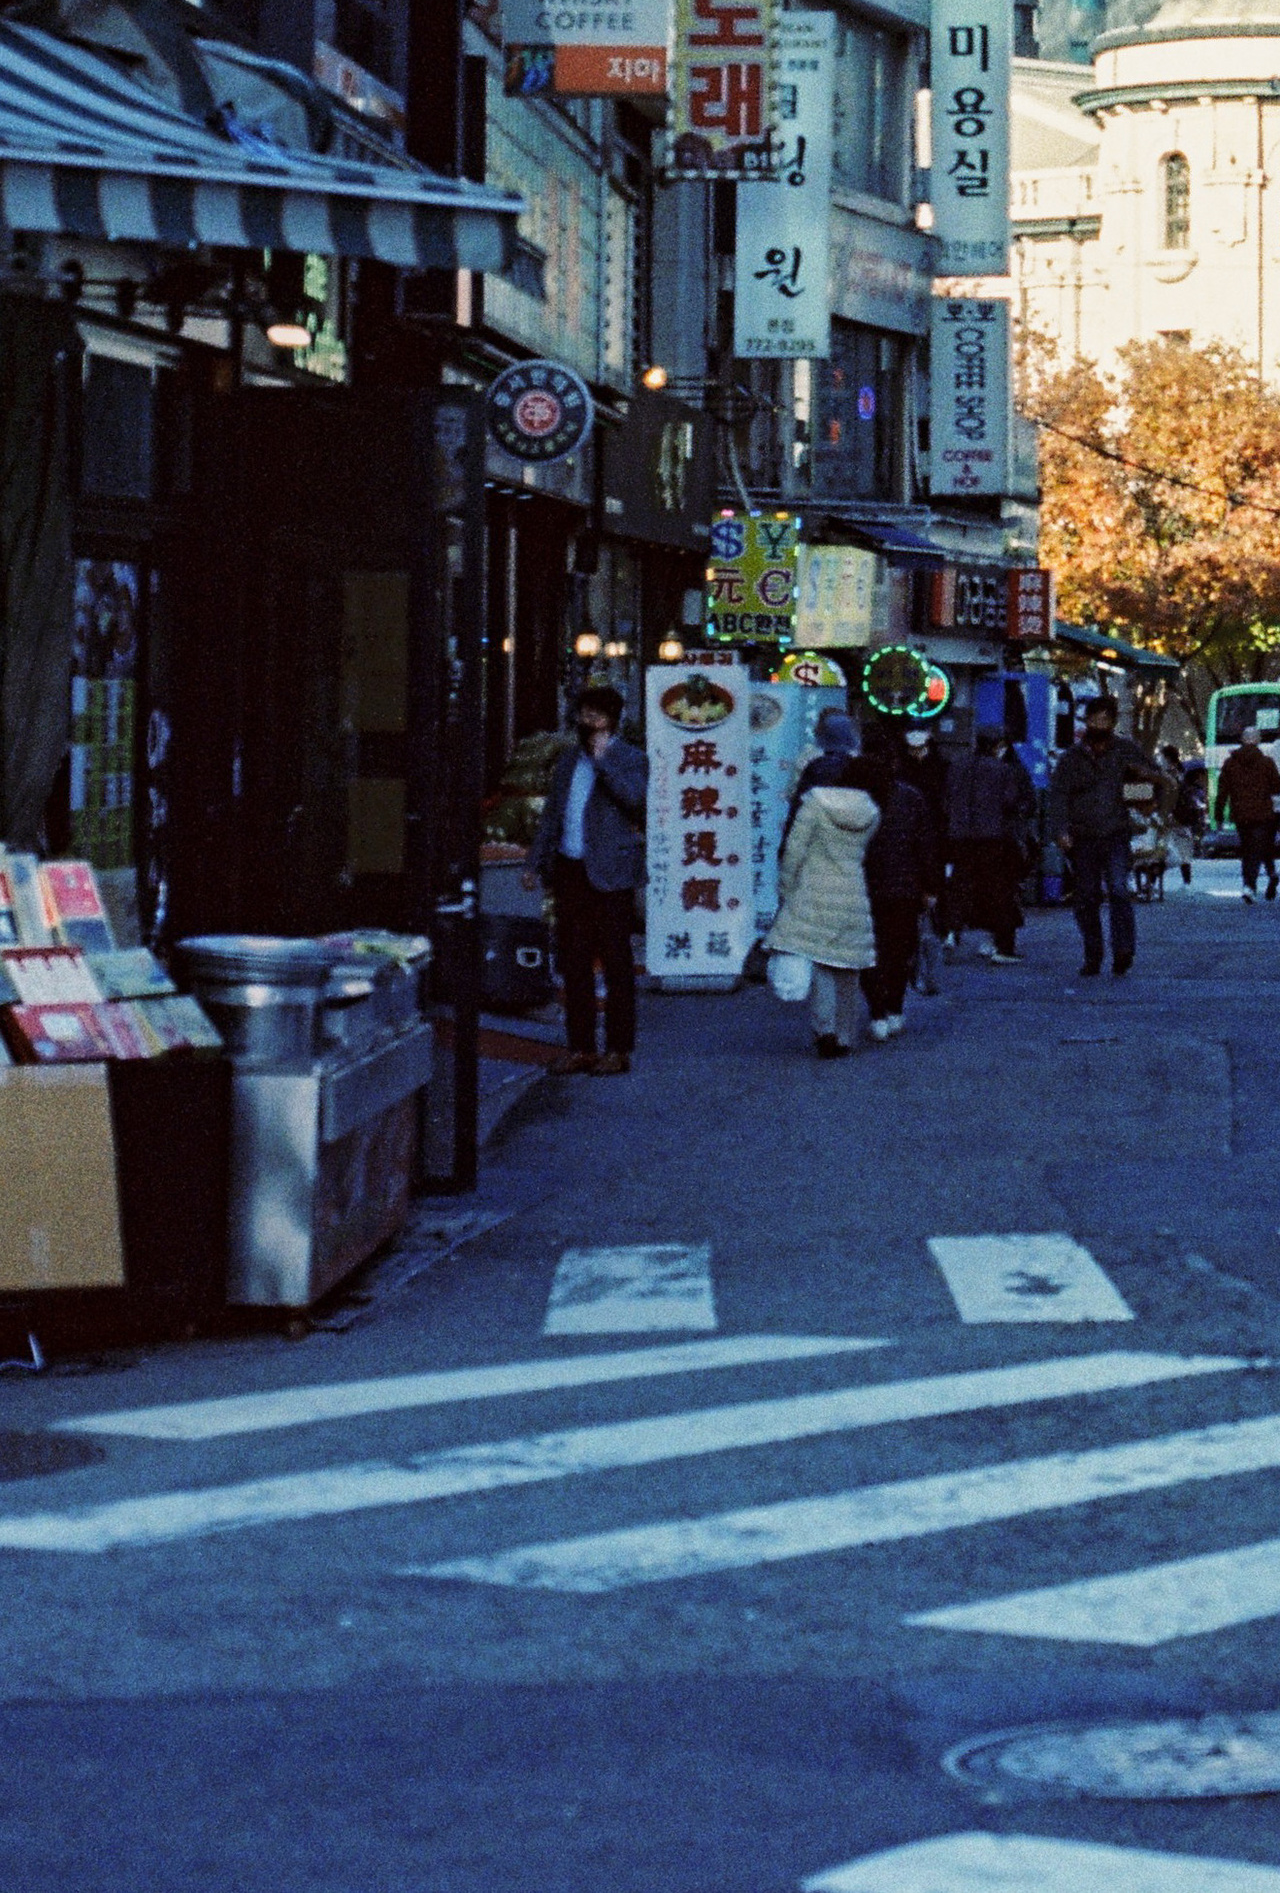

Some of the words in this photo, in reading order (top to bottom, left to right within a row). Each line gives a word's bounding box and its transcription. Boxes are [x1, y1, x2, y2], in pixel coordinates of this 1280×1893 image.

[536, 11, 632, 31] COFFEE
[947, 23, 995, 198] 미용실
[955, 327, 986, 389] COFFEE
[955, 395, 986, 440] SHOP
